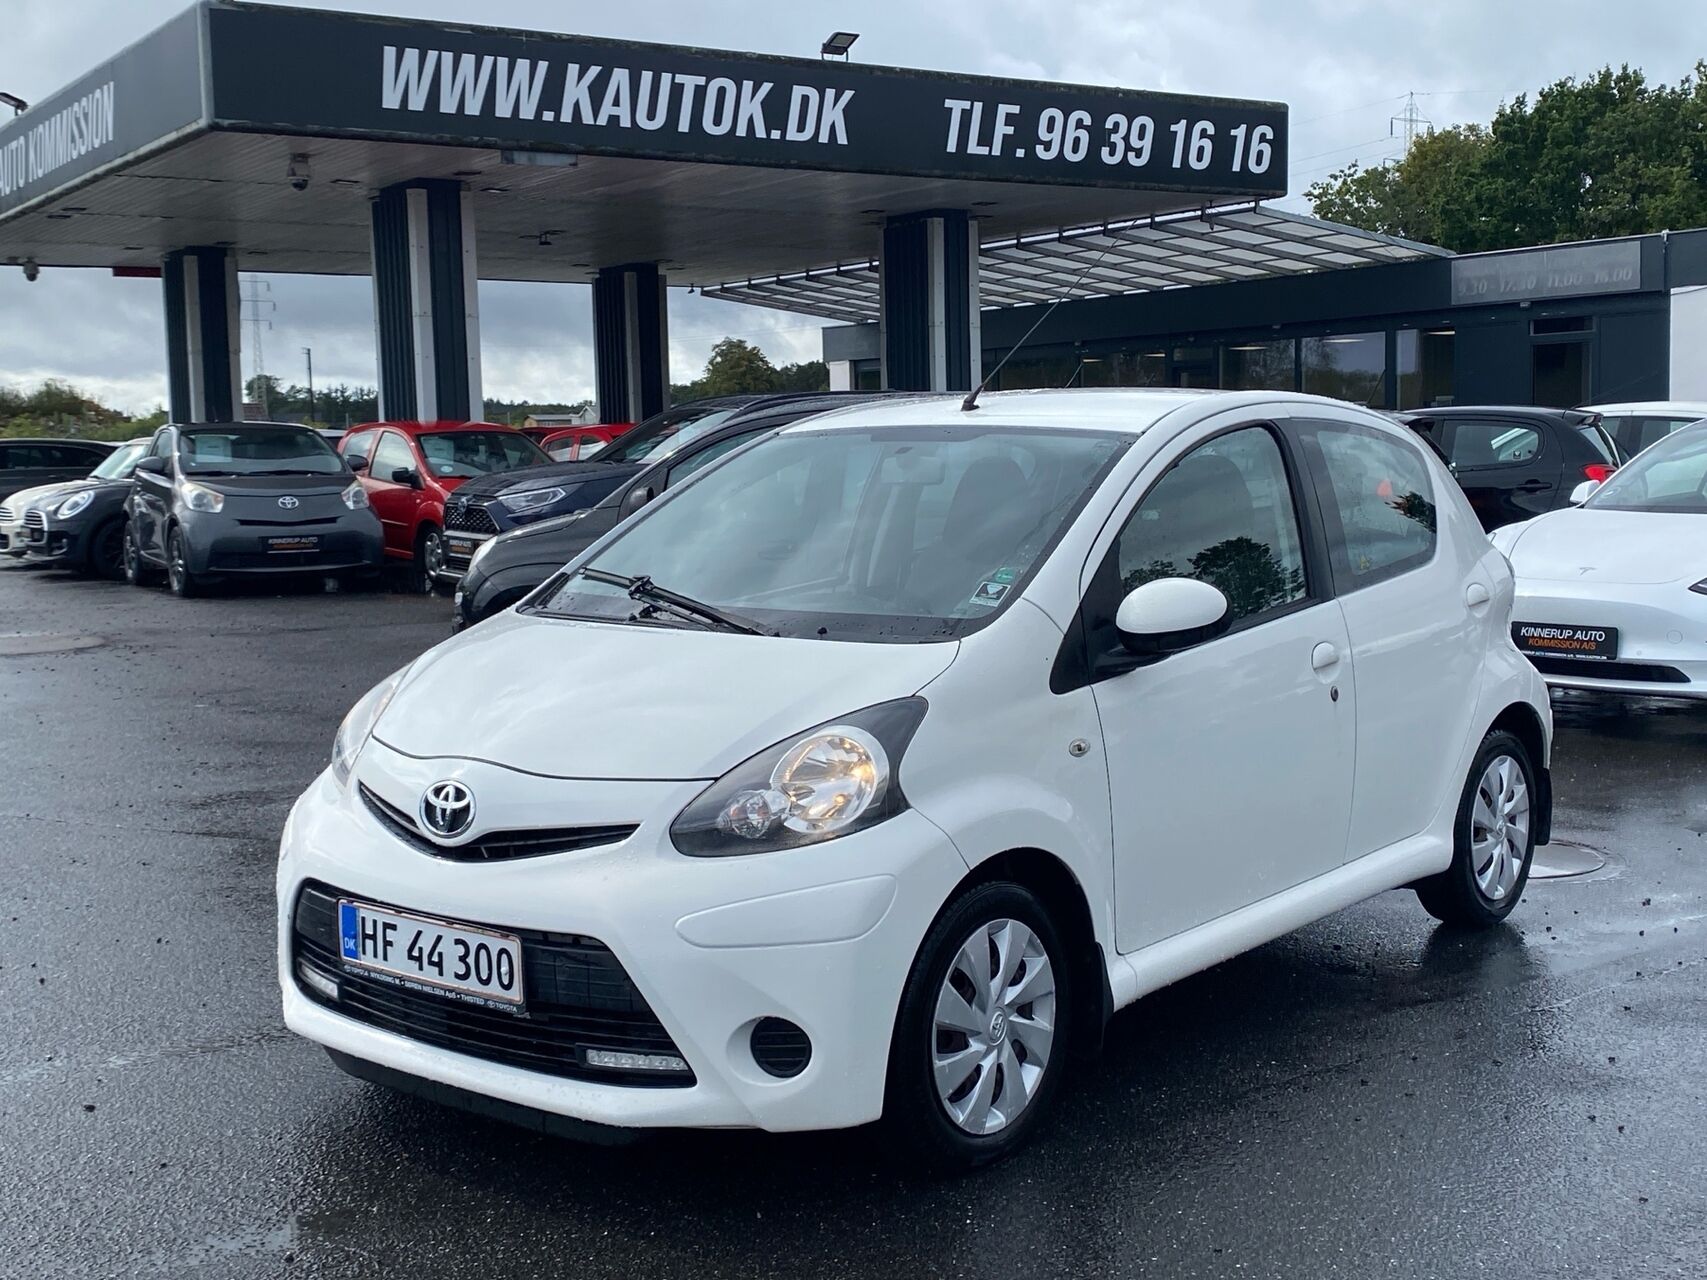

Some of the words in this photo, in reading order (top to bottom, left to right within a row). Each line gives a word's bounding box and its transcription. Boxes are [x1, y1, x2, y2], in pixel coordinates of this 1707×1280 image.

[382, 45, 856, 146] WWW.KAUTOK.DK
[28, 81, 115, 183] KOMMISSION
[943, 98, 1026, 158] TLF.
[1035, 107, 1092, 163] 96
[1100, 113, 1155, 167] 39
[1169, 119, 1215, 170] 16
[1230, 124, 1274, 174] 16
[1520, 626, 1573, 639] KINNERUP
[1574, 630, 1606, 641] AUTO
[1528, 638, 1580, 649] KOMMISSION
[343, 936, 356, 951] DK
[361, 916, 398, 962] HF
